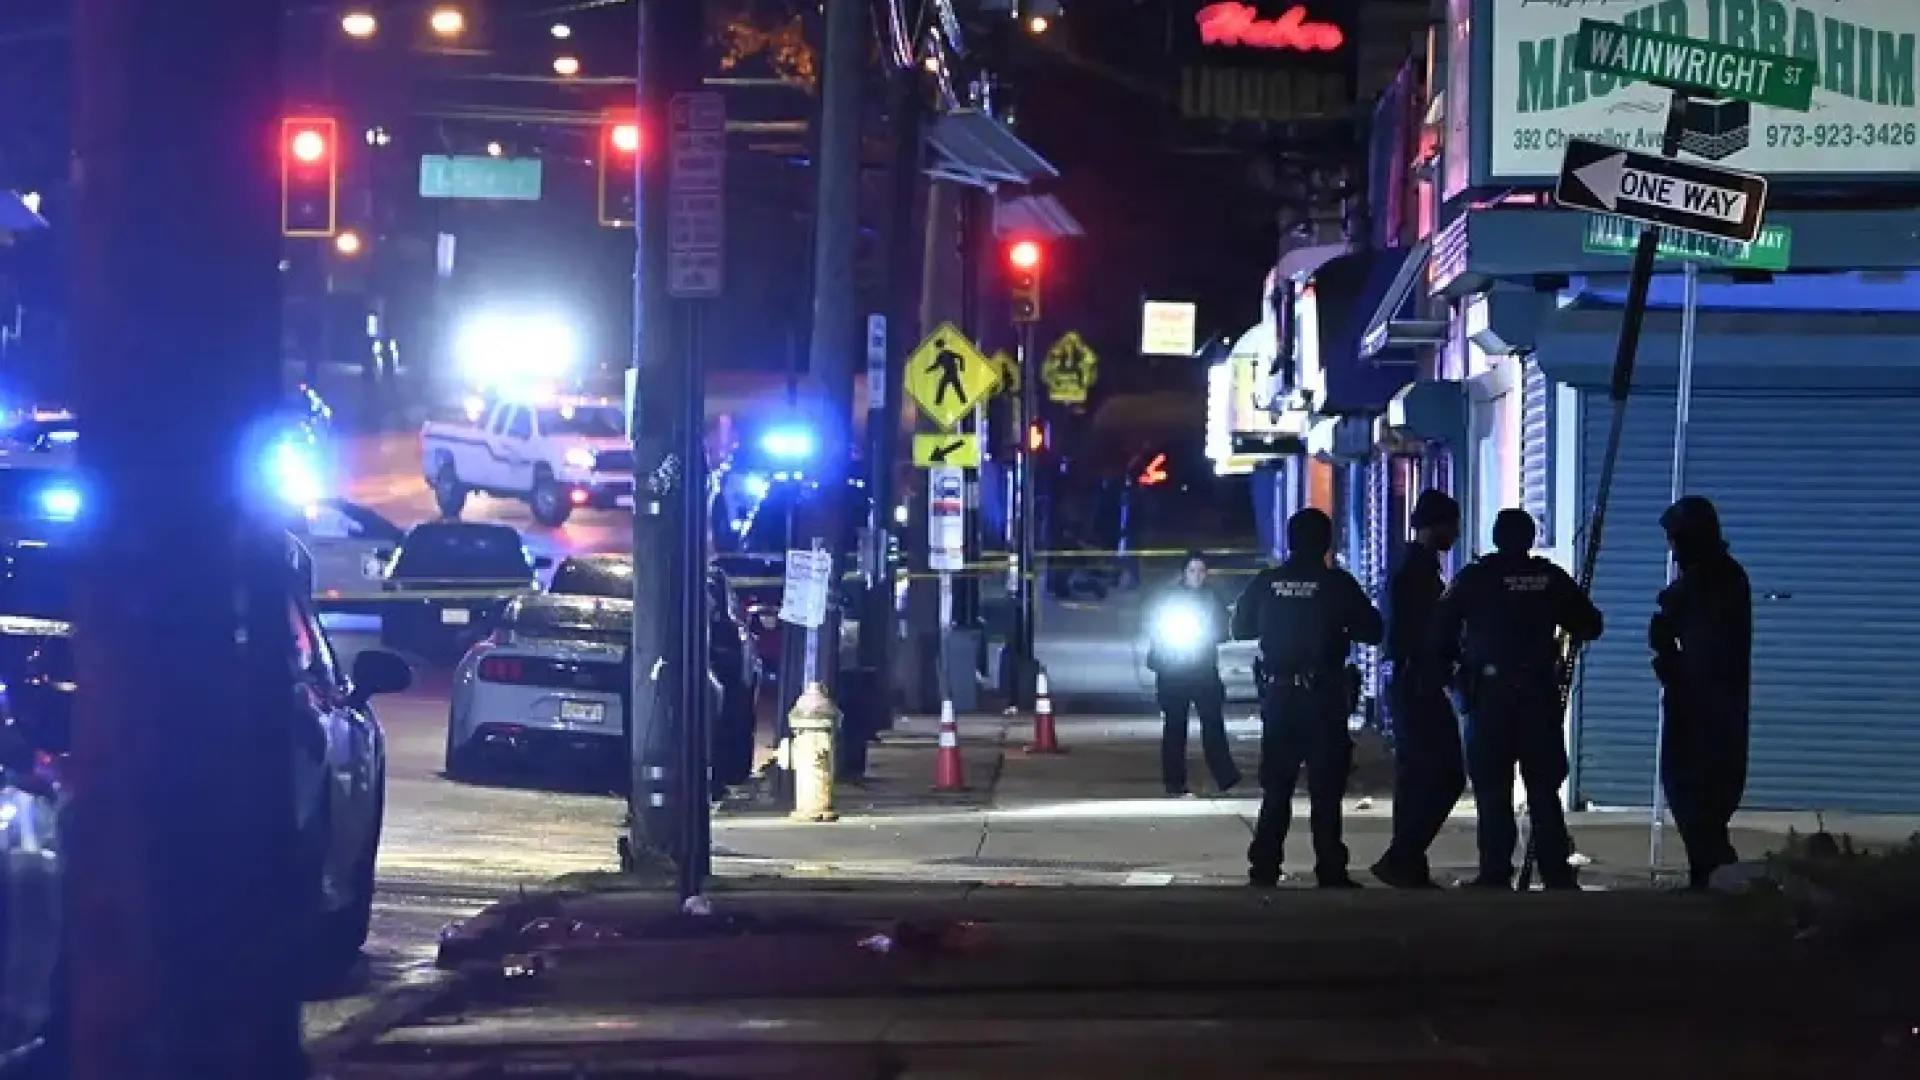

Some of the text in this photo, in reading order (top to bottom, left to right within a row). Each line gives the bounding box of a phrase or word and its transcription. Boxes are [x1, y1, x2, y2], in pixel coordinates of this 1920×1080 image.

[1590, 29, 1803, 95] WAINWRIGHT ST
[1513, 128, 1541, 150] 392
[1766, 123, 1915, 147] 973-923-3426
[1621, 170, 1739, 216] ONE WAY
